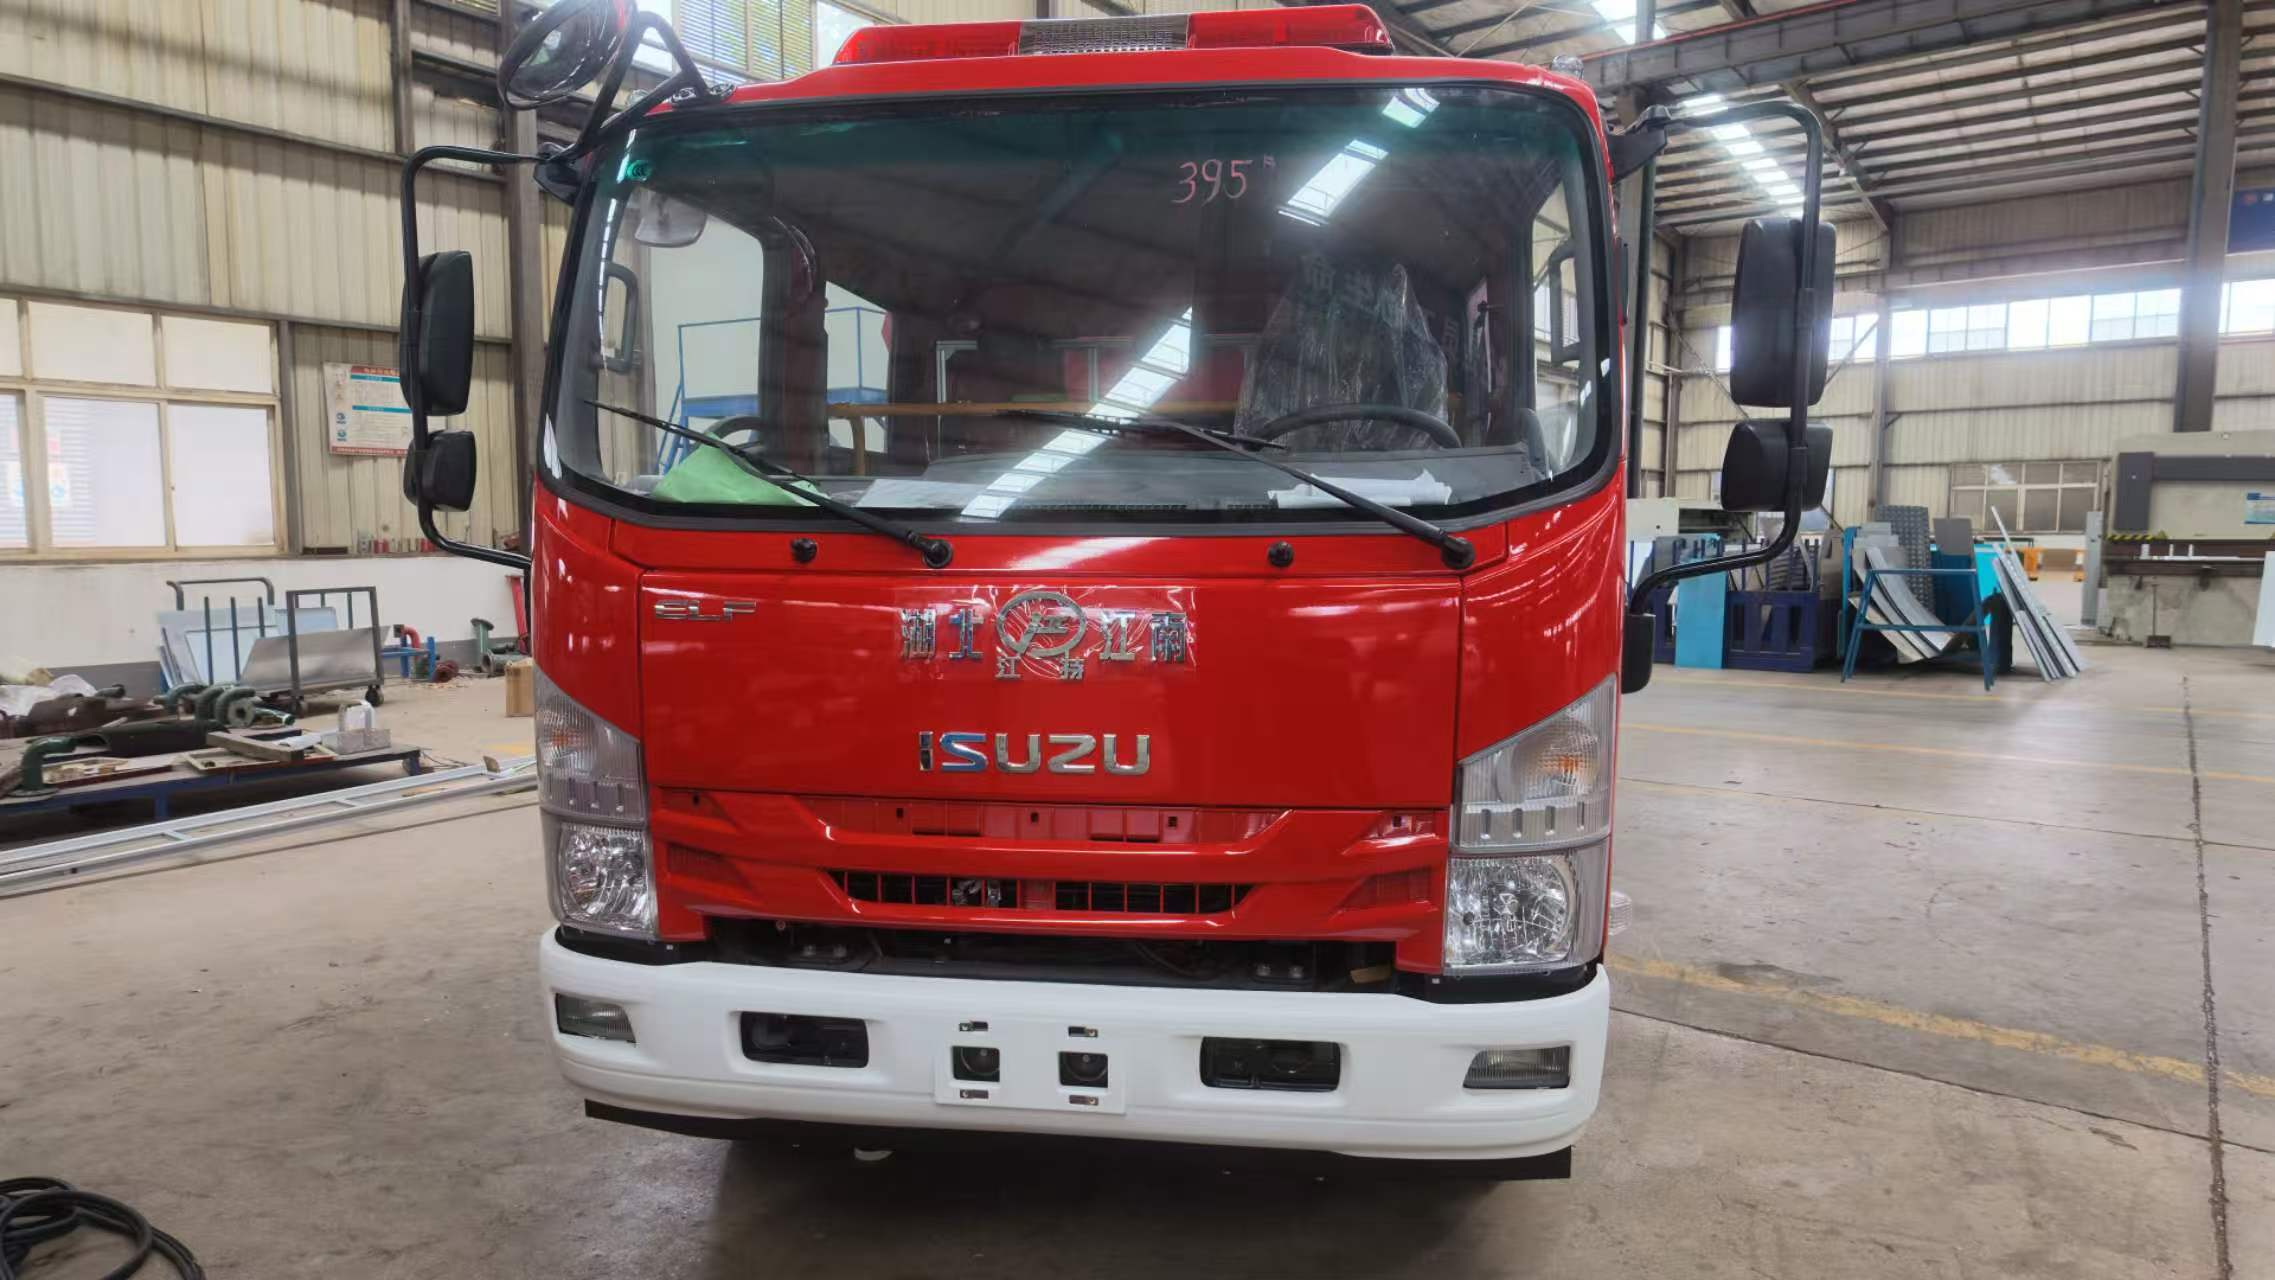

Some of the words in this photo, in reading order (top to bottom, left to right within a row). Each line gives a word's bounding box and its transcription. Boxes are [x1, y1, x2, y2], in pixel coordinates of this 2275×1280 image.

[1171, 158, 1253, 207] 395
[654, 599, 757, 622] ELF
[918, 730, 1151, 775] ISUZU
